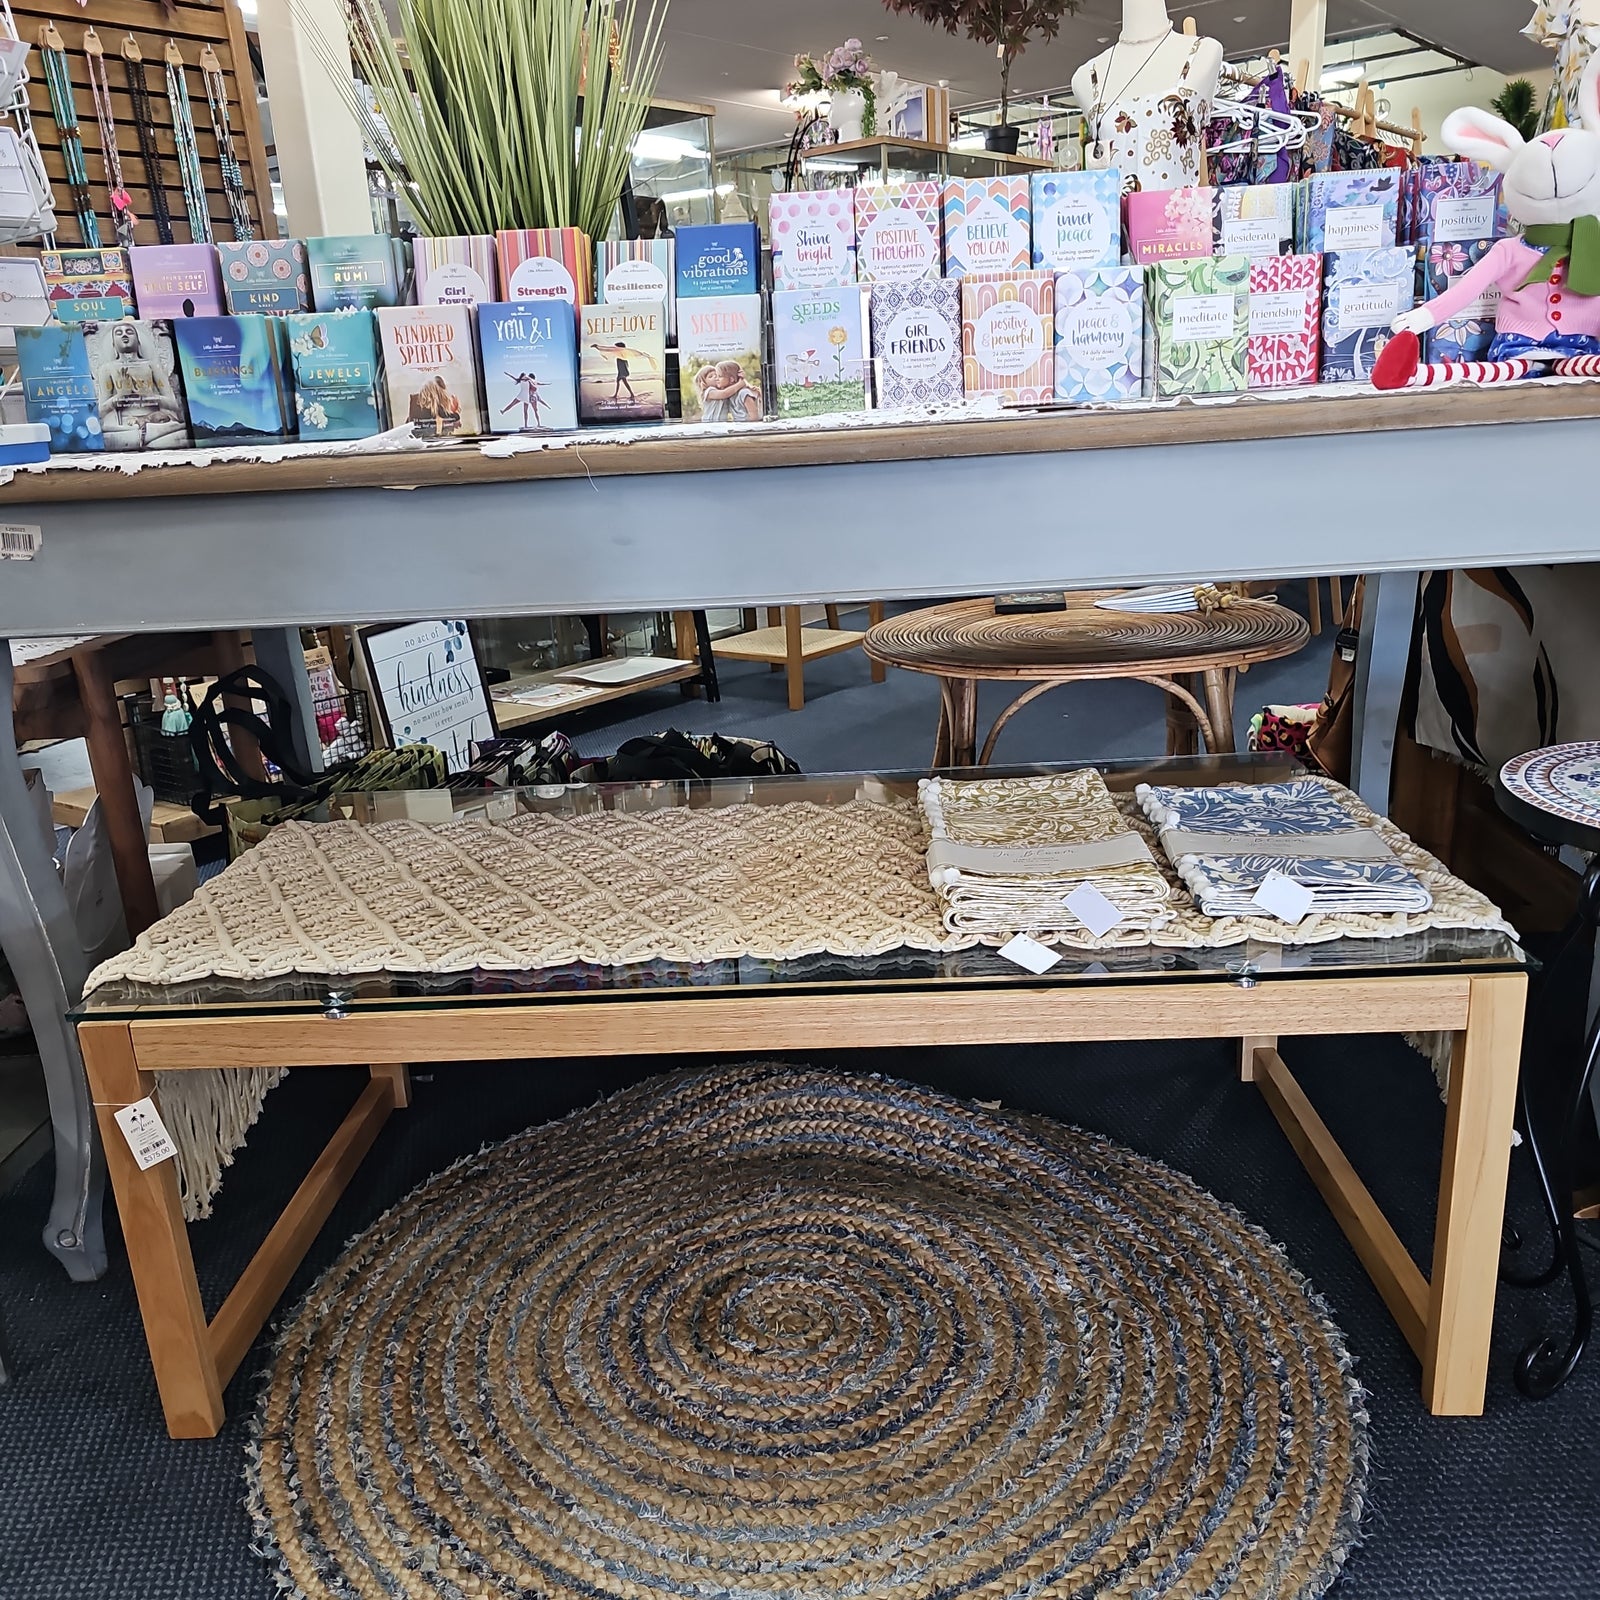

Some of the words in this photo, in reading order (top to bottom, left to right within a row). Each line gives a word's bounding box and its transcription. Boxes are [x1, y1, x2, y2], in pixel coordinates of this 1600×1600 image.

[1057, 211, 1094, 226] inner
[1442, 215, 1488, 228] positivity
[876, 228, 920, 244] POSITIVE
[967, 223, 1008, 240] BELIEVE
[1227, 232, 1276, 244] desiderata
[1328, 224, 1379, 236] happiness
[796, 230, 830, 247] Shine
[1058, 229, 1094, 248] peace
[797, 246, 832, 265] bright
[870, 244, 925, 260] THOUGHTS
[966, 242, 986, 256] YOU
[990, 240, 1010, 254] CAN
[1142, 240, 1203, 255] MIRACLES
[698, 249, 730, 268] good
[334, 271, 368, 282] RUMI
[682, 264, 748, 278] vibrations
[178, 281, 204, 292] SELF
[444, 287, 466, 296] Girl
[517, 286, 568, 298] Strength
[607, 282, 664, 292] Resilience
[73, 300, 106, 312] SOUL
[250, 292, 280, 304] KIND
[1344, 298, 1393, 314] gratitude
[792, 301, 840, 324] SEEDS
[1179, 311, 1228, 324] meditate
[1251, 308, 1302, 319] friendship
[492, 318, 527, 342] YOU
[530, 317, 545, 344] &
[546, 318, 552, 340] I
[586, 314, 656, 336] SELF-LOVE
[690, 312, 748, 336] SISTERS
[906, 324, 930, 338] GIRL
[990, 316, 1028, 334] positive
[1078, 318, 1108, 334] peace
[1110, 314, 1118, 328] &
[394, 324, 455, 345] KINDRED
[982, 333, 990, 348] &
[992, 328, 1034, 350] powerful
[1072, 330, 1124, 348] harmony
[891, 338, 946, 354] FRIENDS
[399, 344, 454, 366] SPIRITS
[194, 366, 254, 377] BLESSINGS
[309, 368, 361, 380] JEWELS
[37, 385, 90, 397] ANGELS
[405, 638, 414, 648] no
[417, 633, 430, 645] act
[431, 627, 440, 640] of
[395, 652, 474, 712] kindness
[422, 709, 441, 722] matter
[442, 703, 454, 714] how
[454, 697, 470, 710] small
[441, 716, 454, 726] ever
[144, 1146, 170, 1164] $375.00
